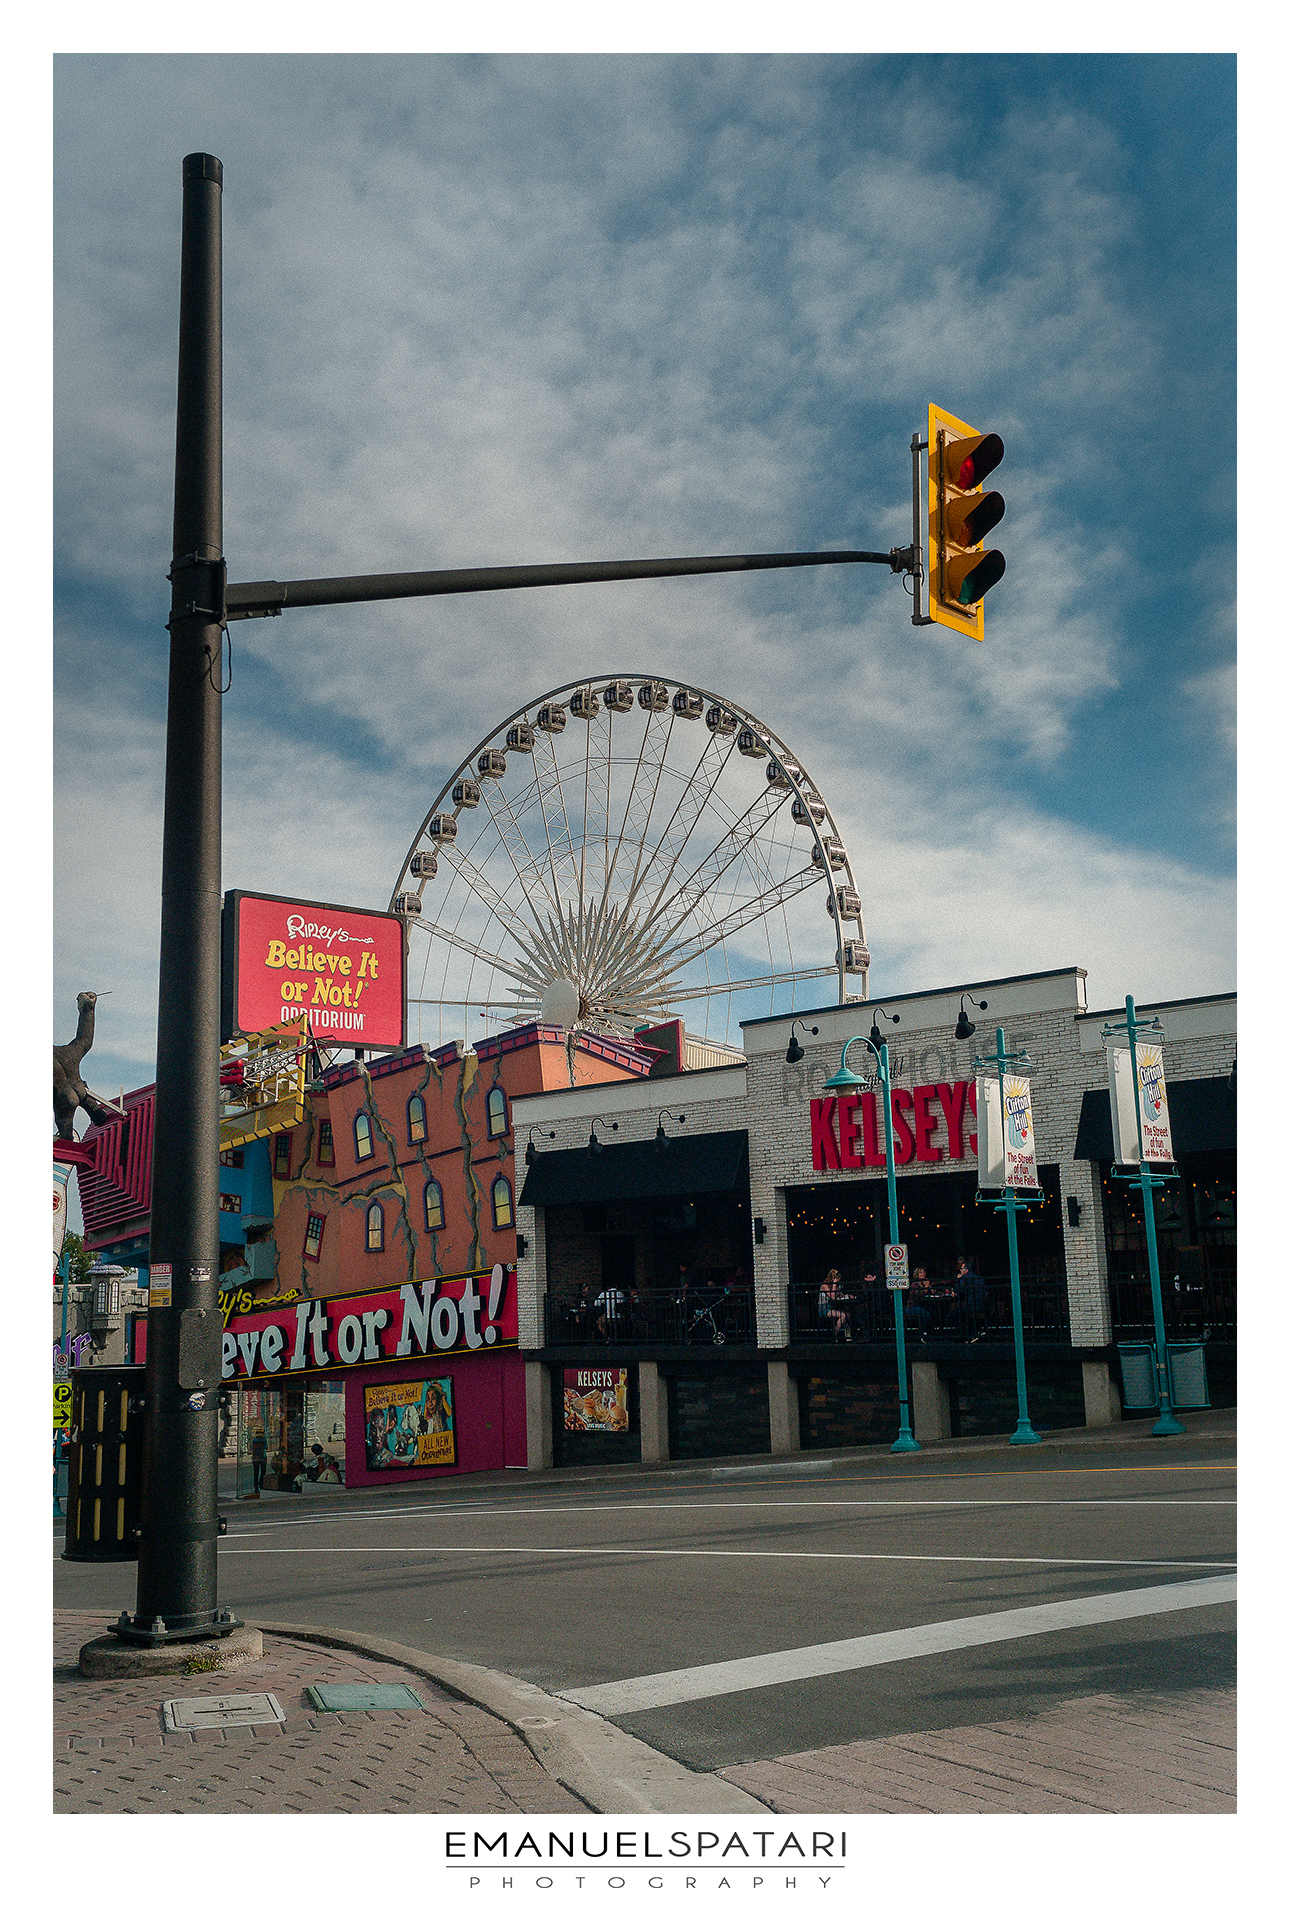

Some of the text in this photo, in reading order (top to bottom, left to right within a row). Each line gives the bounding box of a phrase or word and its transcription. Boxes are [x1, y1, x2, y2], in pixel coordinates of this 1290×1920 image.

[265, 940, 379, 980] Believe It
[281, 977, 364, 1009] or Not!
[1139, 1064, 1163, 1086] Clifton
[1147, 1081, 1162, 1103] Hill
[1006, 1095, 1030, 1115] Clifton
[1013, 1112, 1029, 1132] Hill
[1143, 1125, 1168, 1137] The Street
[1150, 1136, 1155, 1148] of
[1007, 1152, 1034, 1164] The Street
[1014, 1164, 1029, 1175] of fun
[1007, 1175, 1036, 1186] at the Falls
[290, 1299, 330, 1370] It
[338, 1308, 388, 1364] or
[396, 1263, 503, 1357] Not!
[577, 1371, 613, 1387] KELSEYS
[423, 1434, 449, 1450] ALL NEW
